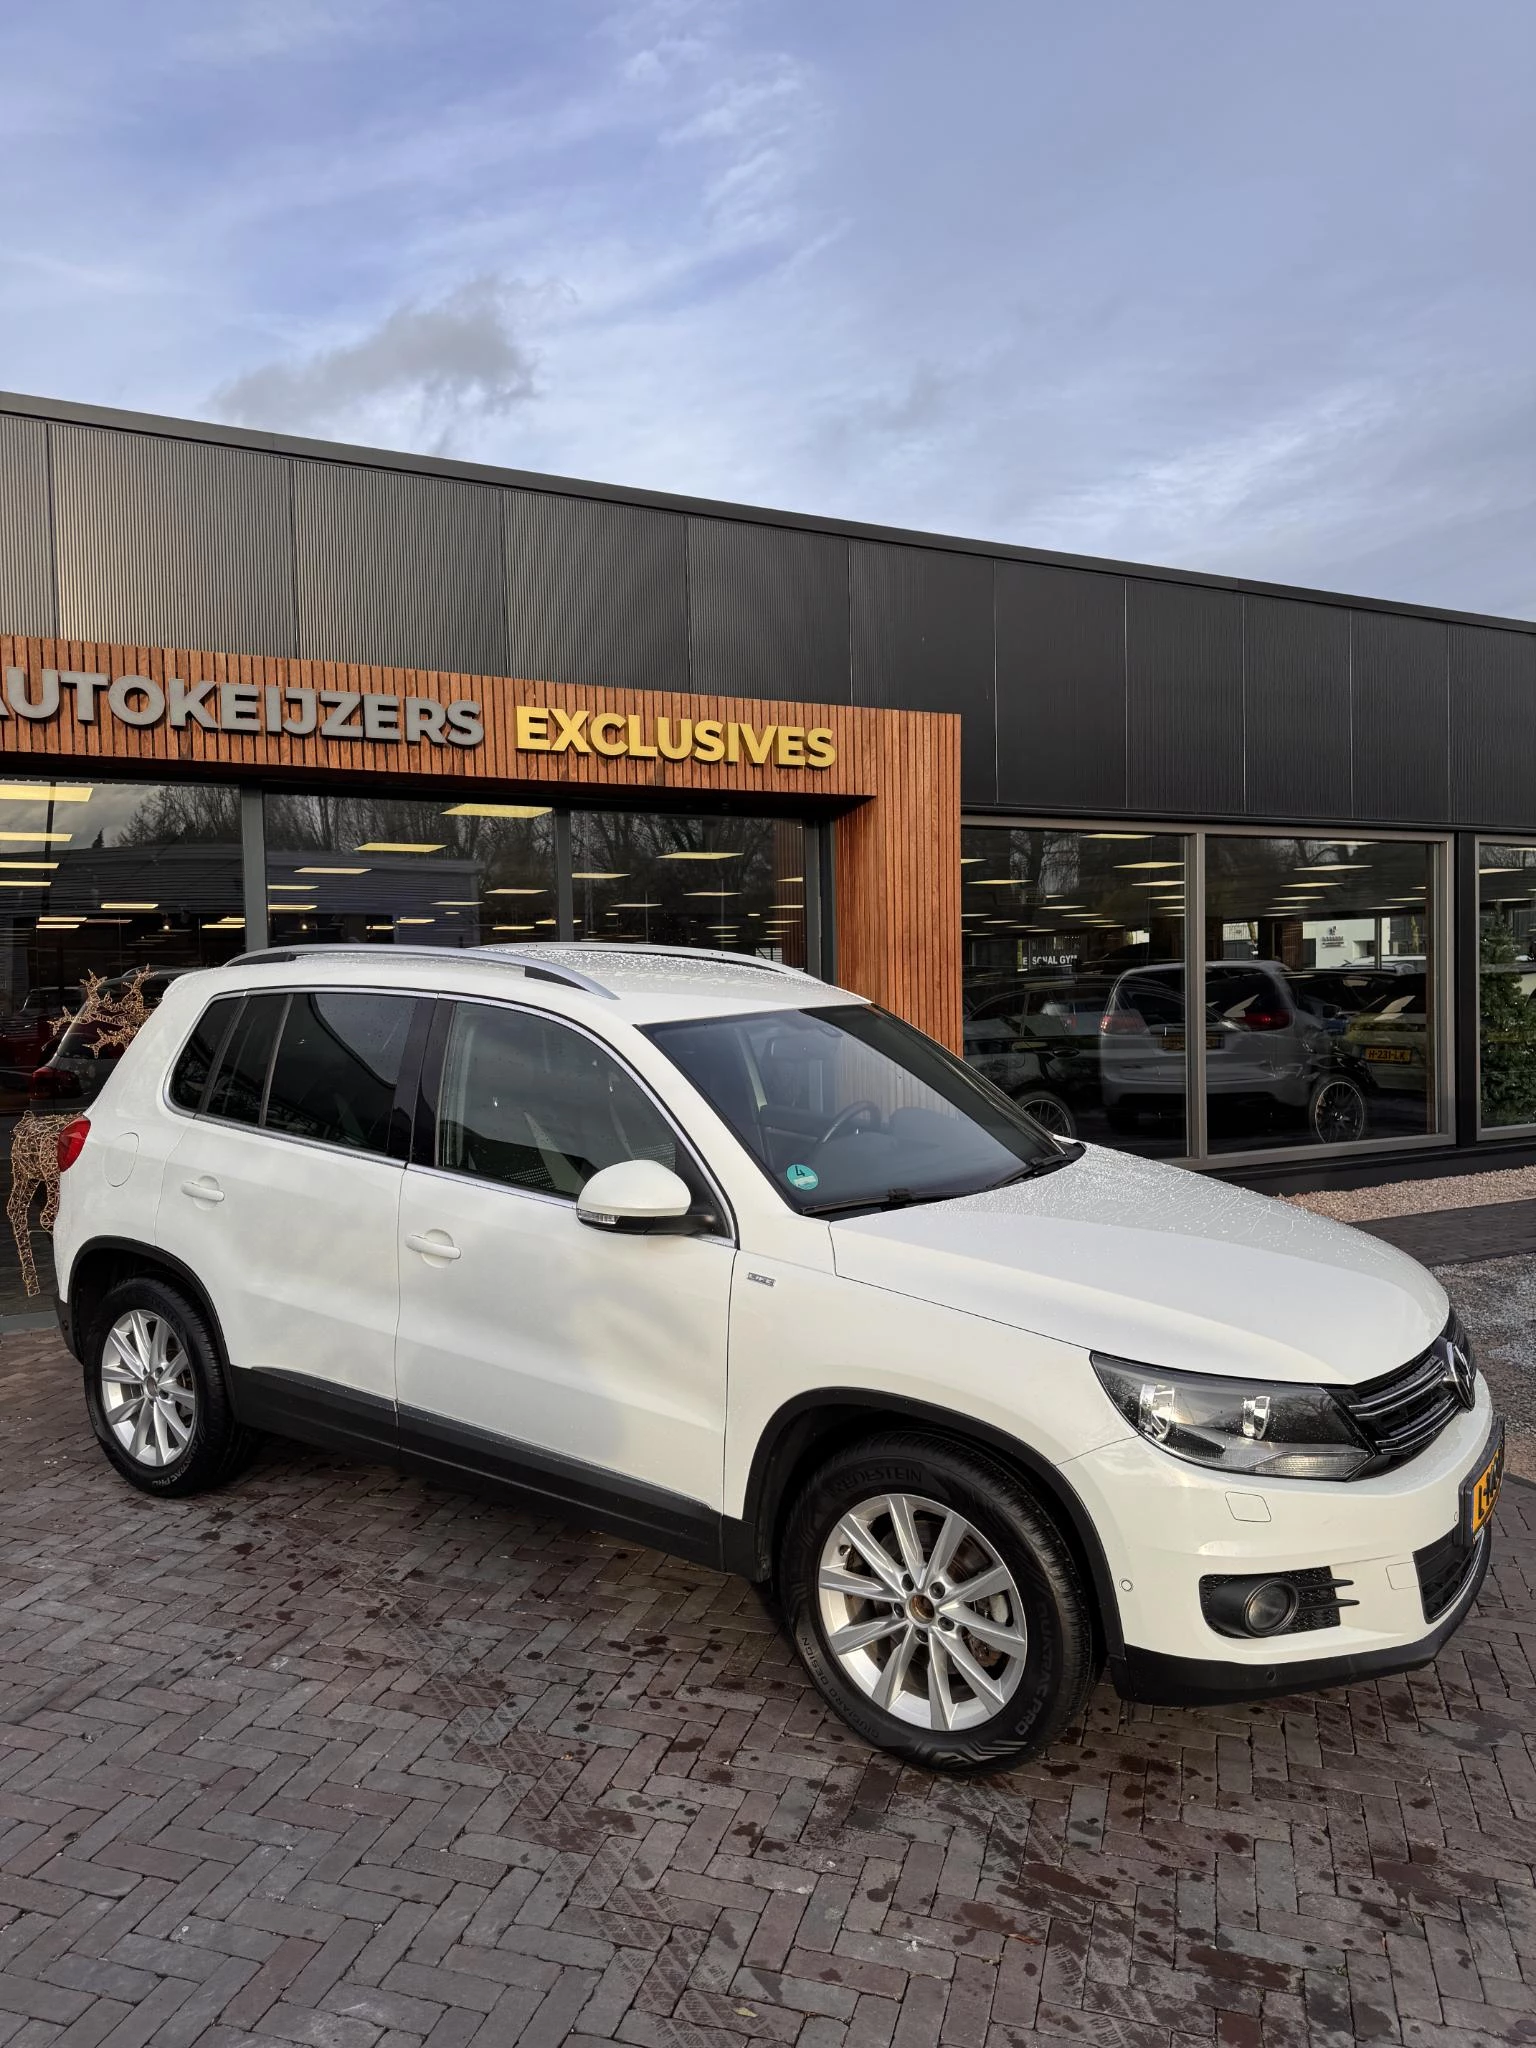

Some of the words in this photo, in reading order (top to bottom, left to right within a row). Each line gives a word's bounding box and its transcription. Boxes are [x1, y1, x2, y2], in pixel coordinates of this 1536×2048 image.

[0, 667, 485, 746] UTOKEIJZERS
[515, 705, 837, 768] EXCLUSIVES
[794, 1165, 806, 1177] 4
[801, 1636, 830, 1687] DESIGN
[1014, 1697, 1044, 1737] PRO
